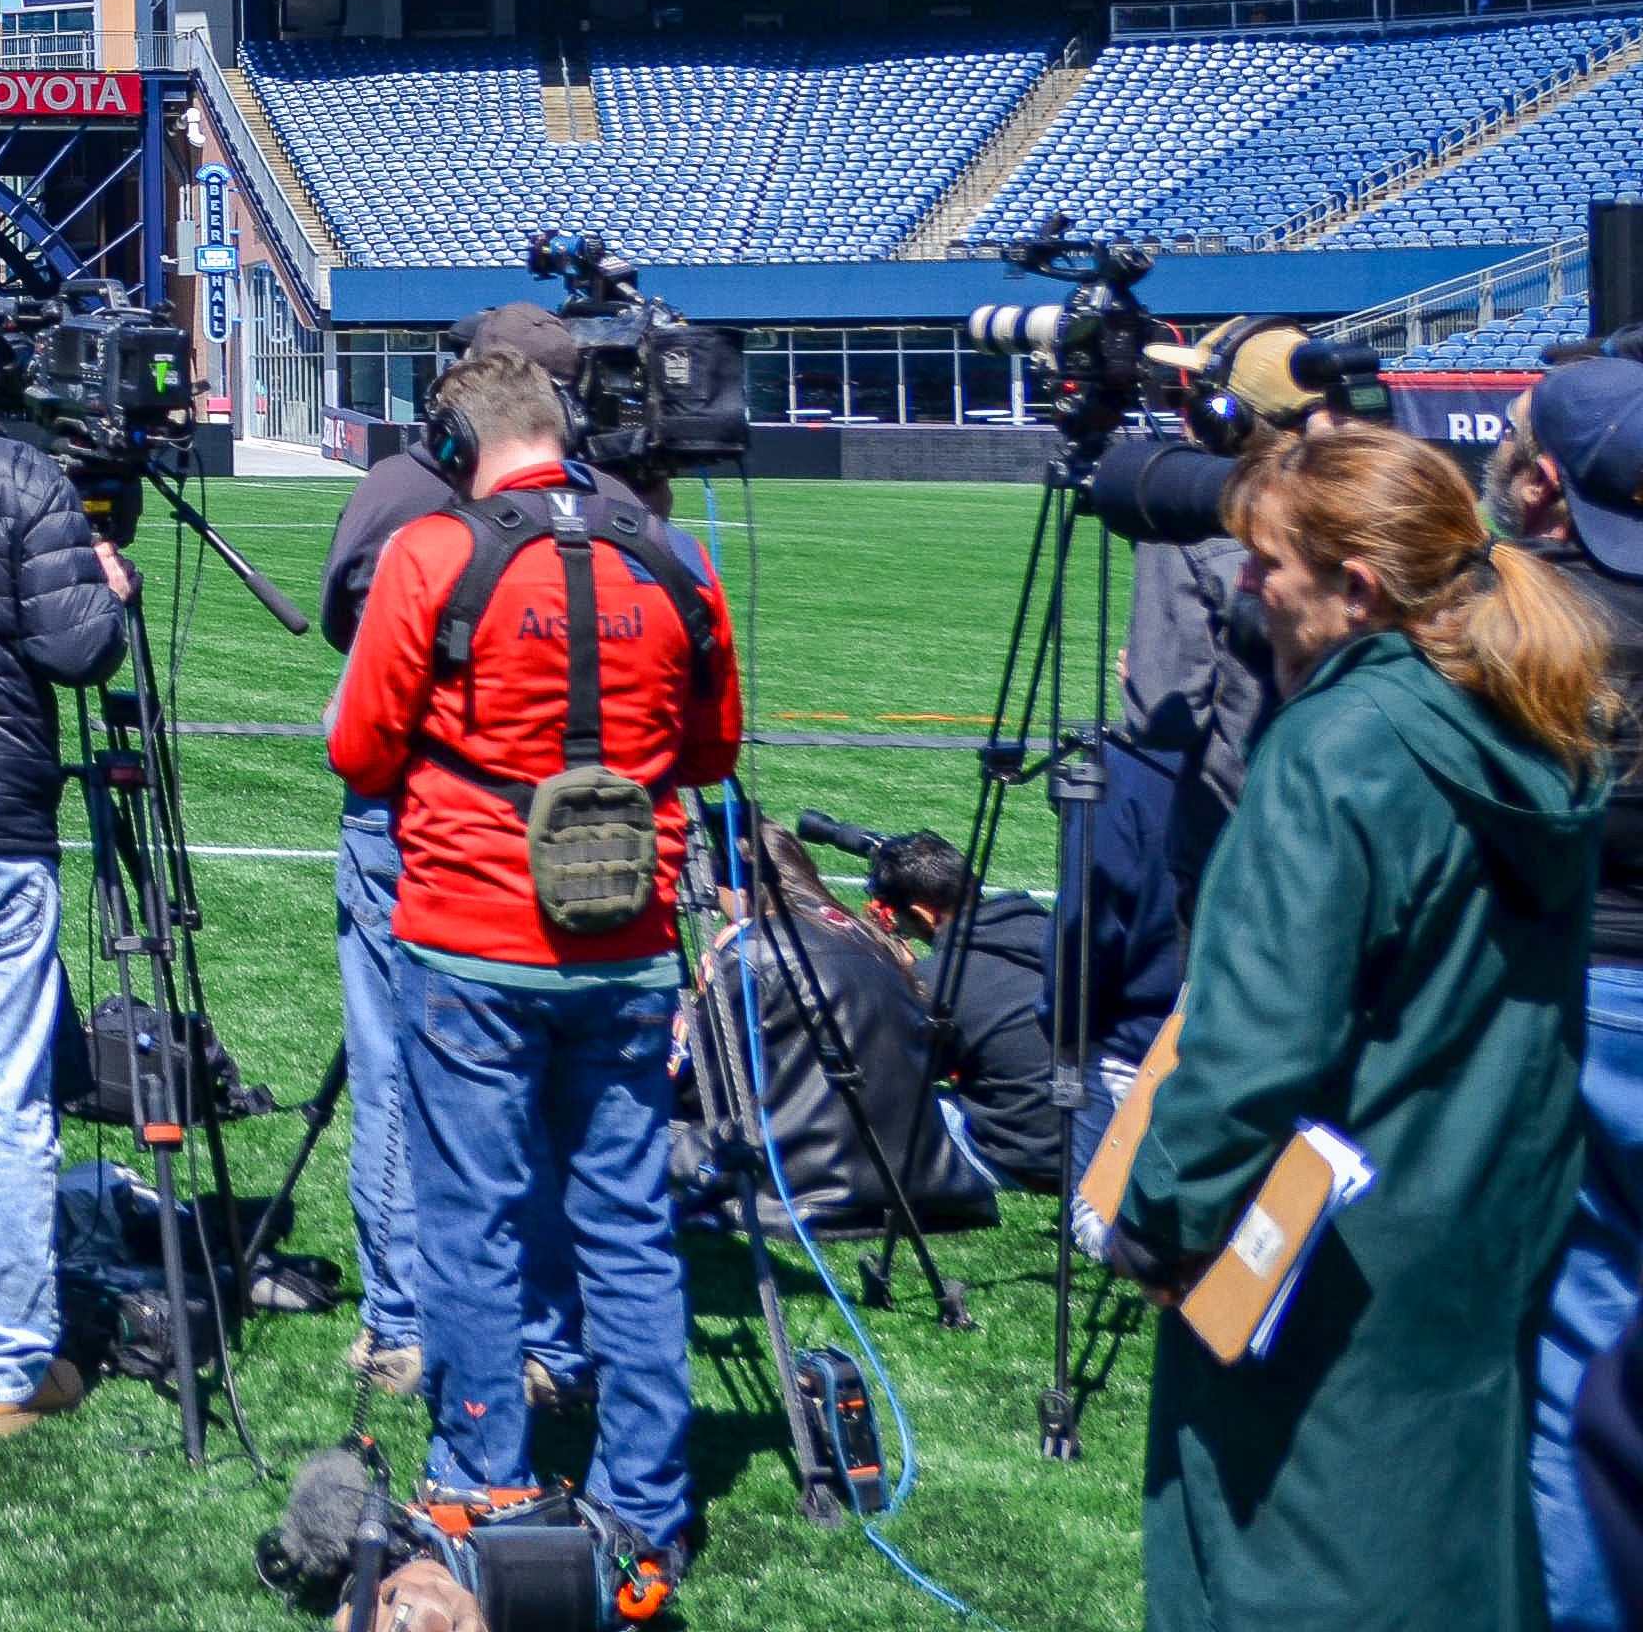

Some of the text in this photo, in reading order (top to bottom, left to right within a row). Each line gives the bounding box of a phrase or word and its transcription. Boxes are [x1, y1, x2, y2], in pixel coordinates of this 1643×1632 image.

[208, 184, 224, 333] BEER HALL
[518, 606, 644, 639] Arsnal
